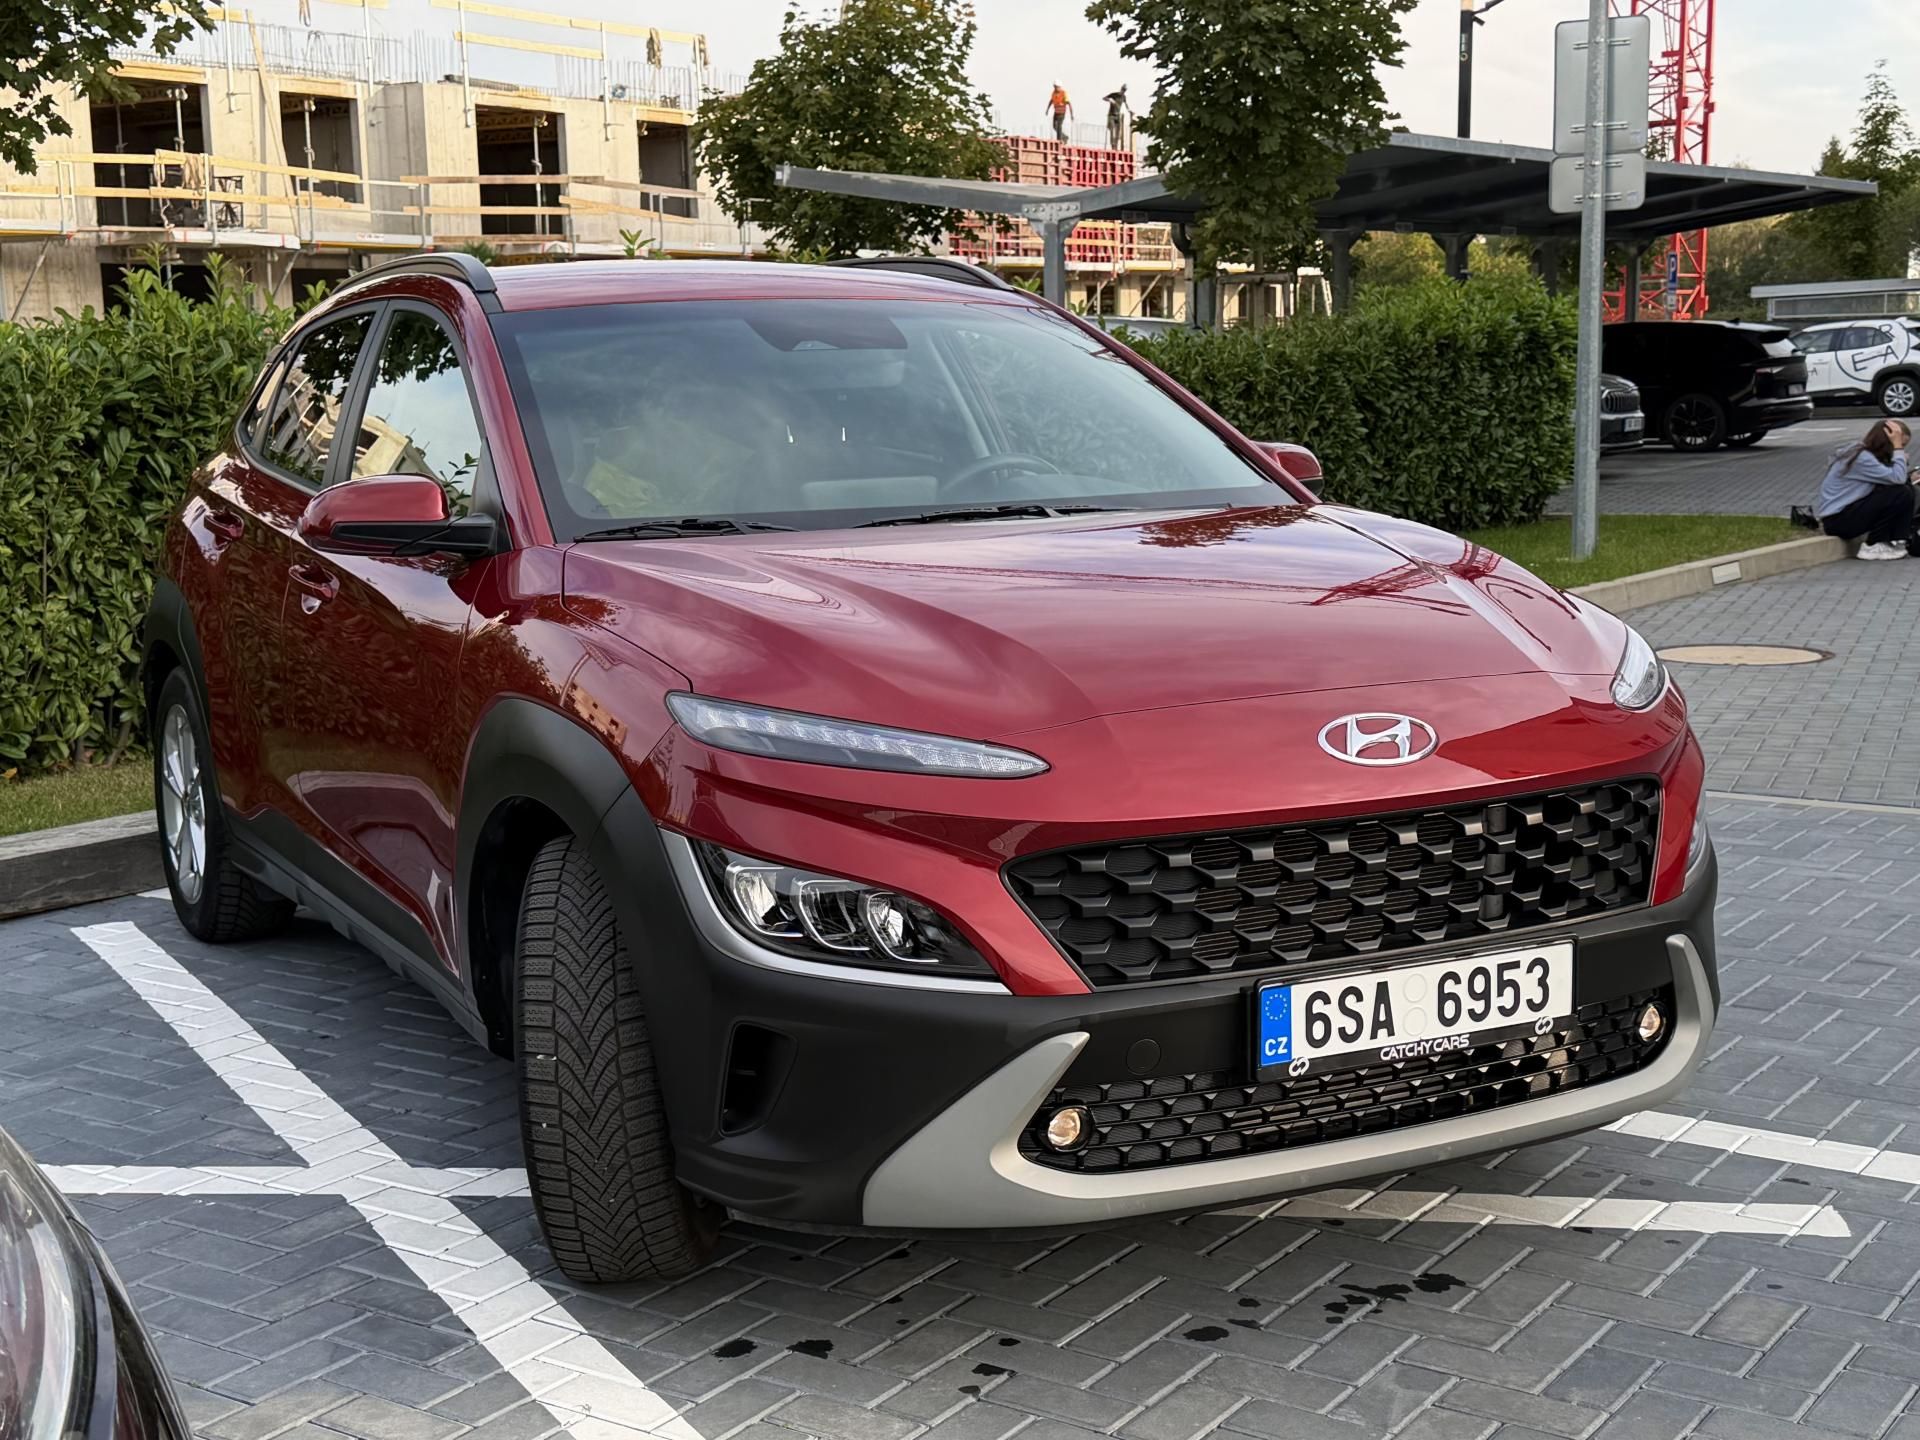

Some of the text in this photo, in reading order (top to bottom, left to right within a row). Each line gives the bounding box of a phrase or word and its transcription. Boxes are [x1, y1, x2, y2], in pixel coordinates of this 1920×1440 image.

[1669, 256, 1677, 281] P
[1304, 957, 1551, 1049] 6SA 6953
[1264, 1036, 1289, 1057] CZ
[1380, 1033, 1471, 1061] CATCHY CARS
